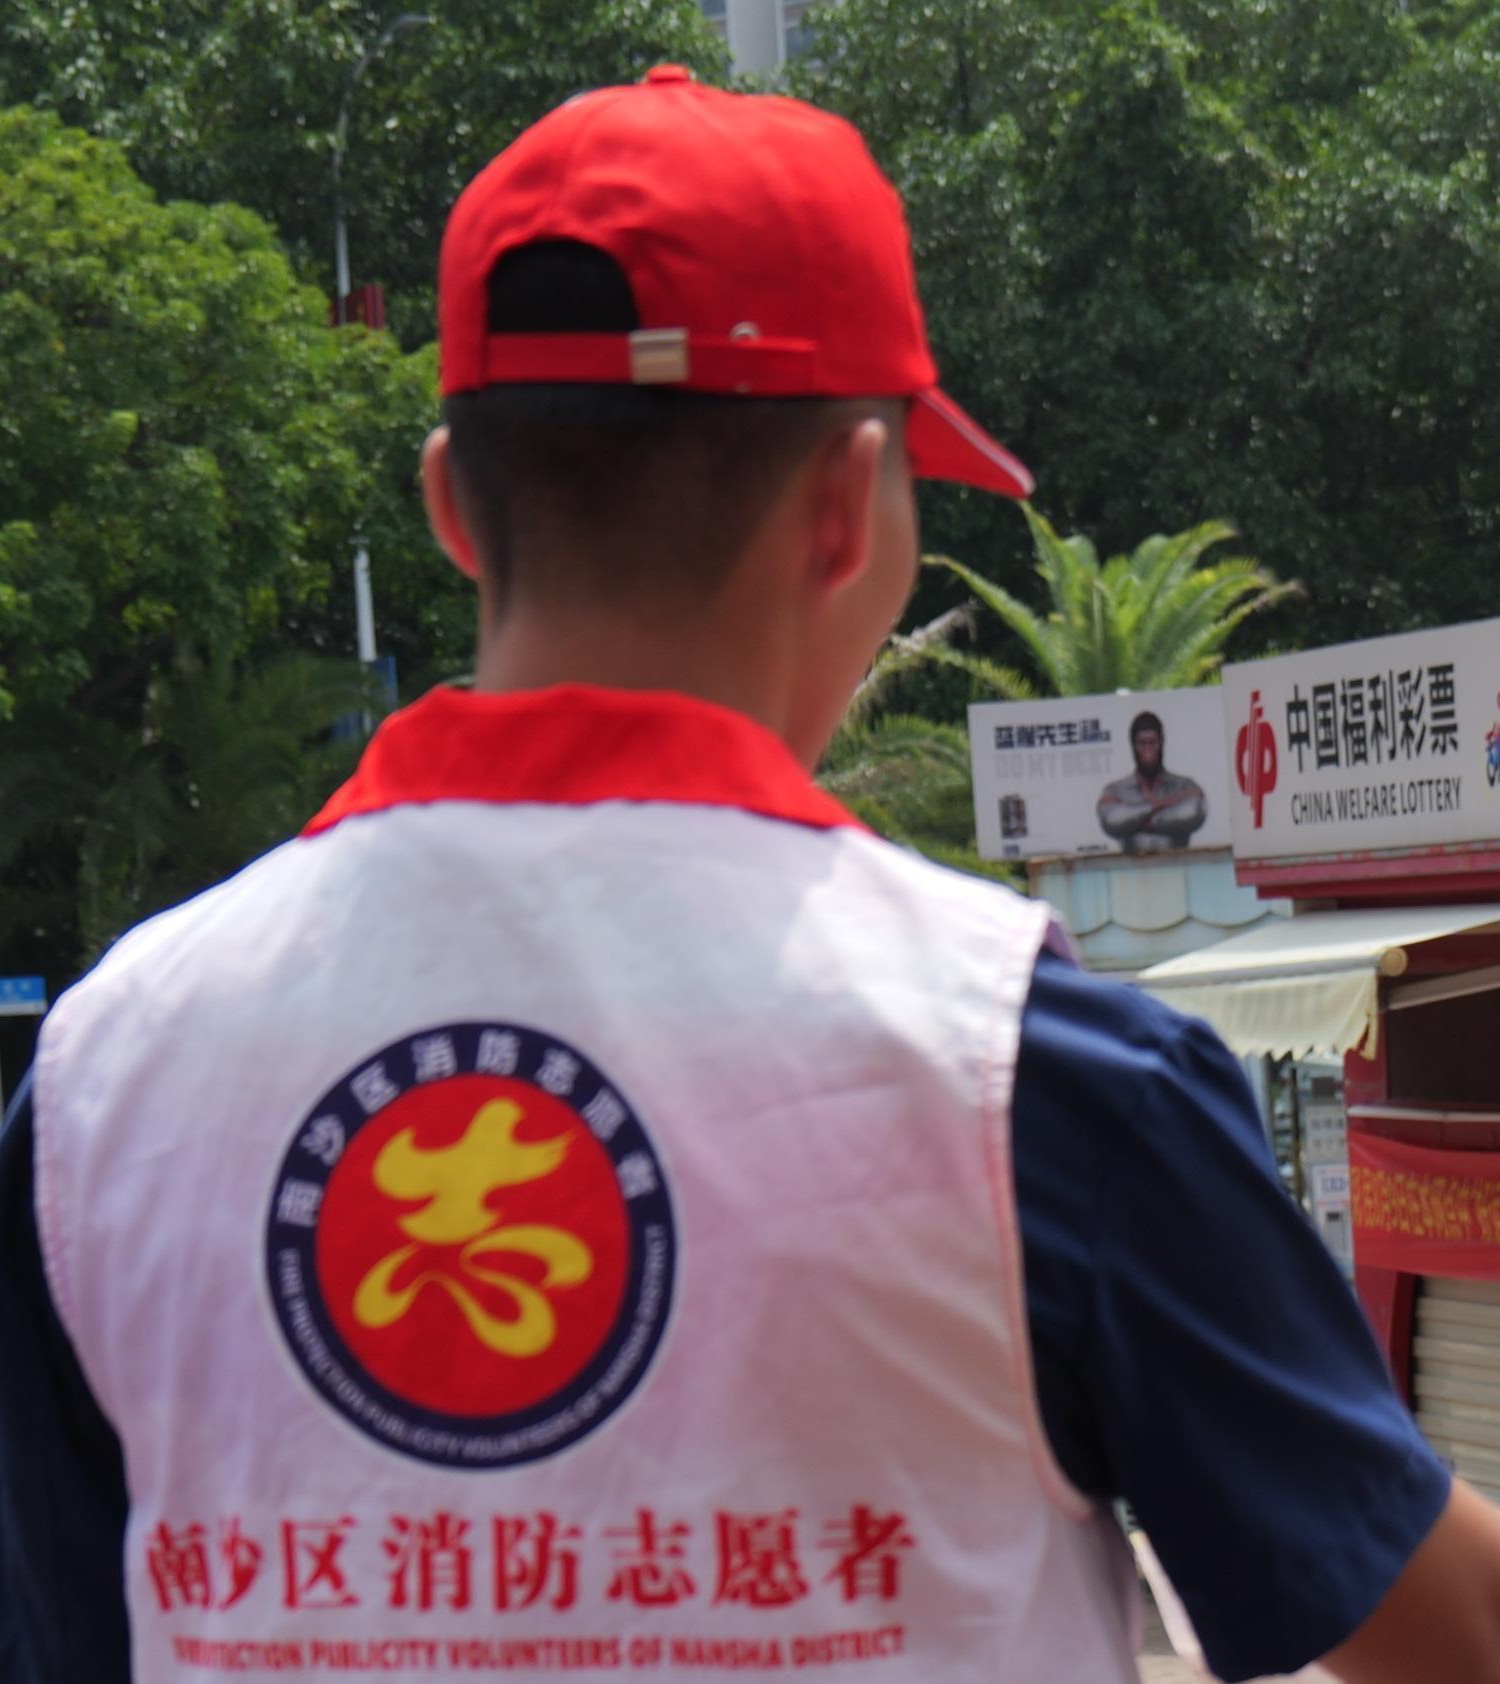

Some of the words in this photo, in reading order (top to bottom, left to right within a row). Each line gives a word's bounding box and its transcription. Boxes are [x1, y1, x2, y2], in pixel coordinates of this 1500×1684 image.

[1286, 662, 1461, 774] 中国福利彩票
[1290, 792, 1333, 825] CHINA
[1336, 784, 1398, 822] WELFARE
[1400, 776, 1462, 816] LOTTERY
[310, 1638, 439, 1670] PUBLICITY
[447, 1636, 622, 1670] VOLUNTEERS
[629, 1637, 661, 1668] OF
[670, 1637, 783, 1669] NANSHA
[790, 1624, 905, 1668] DISTRICT
